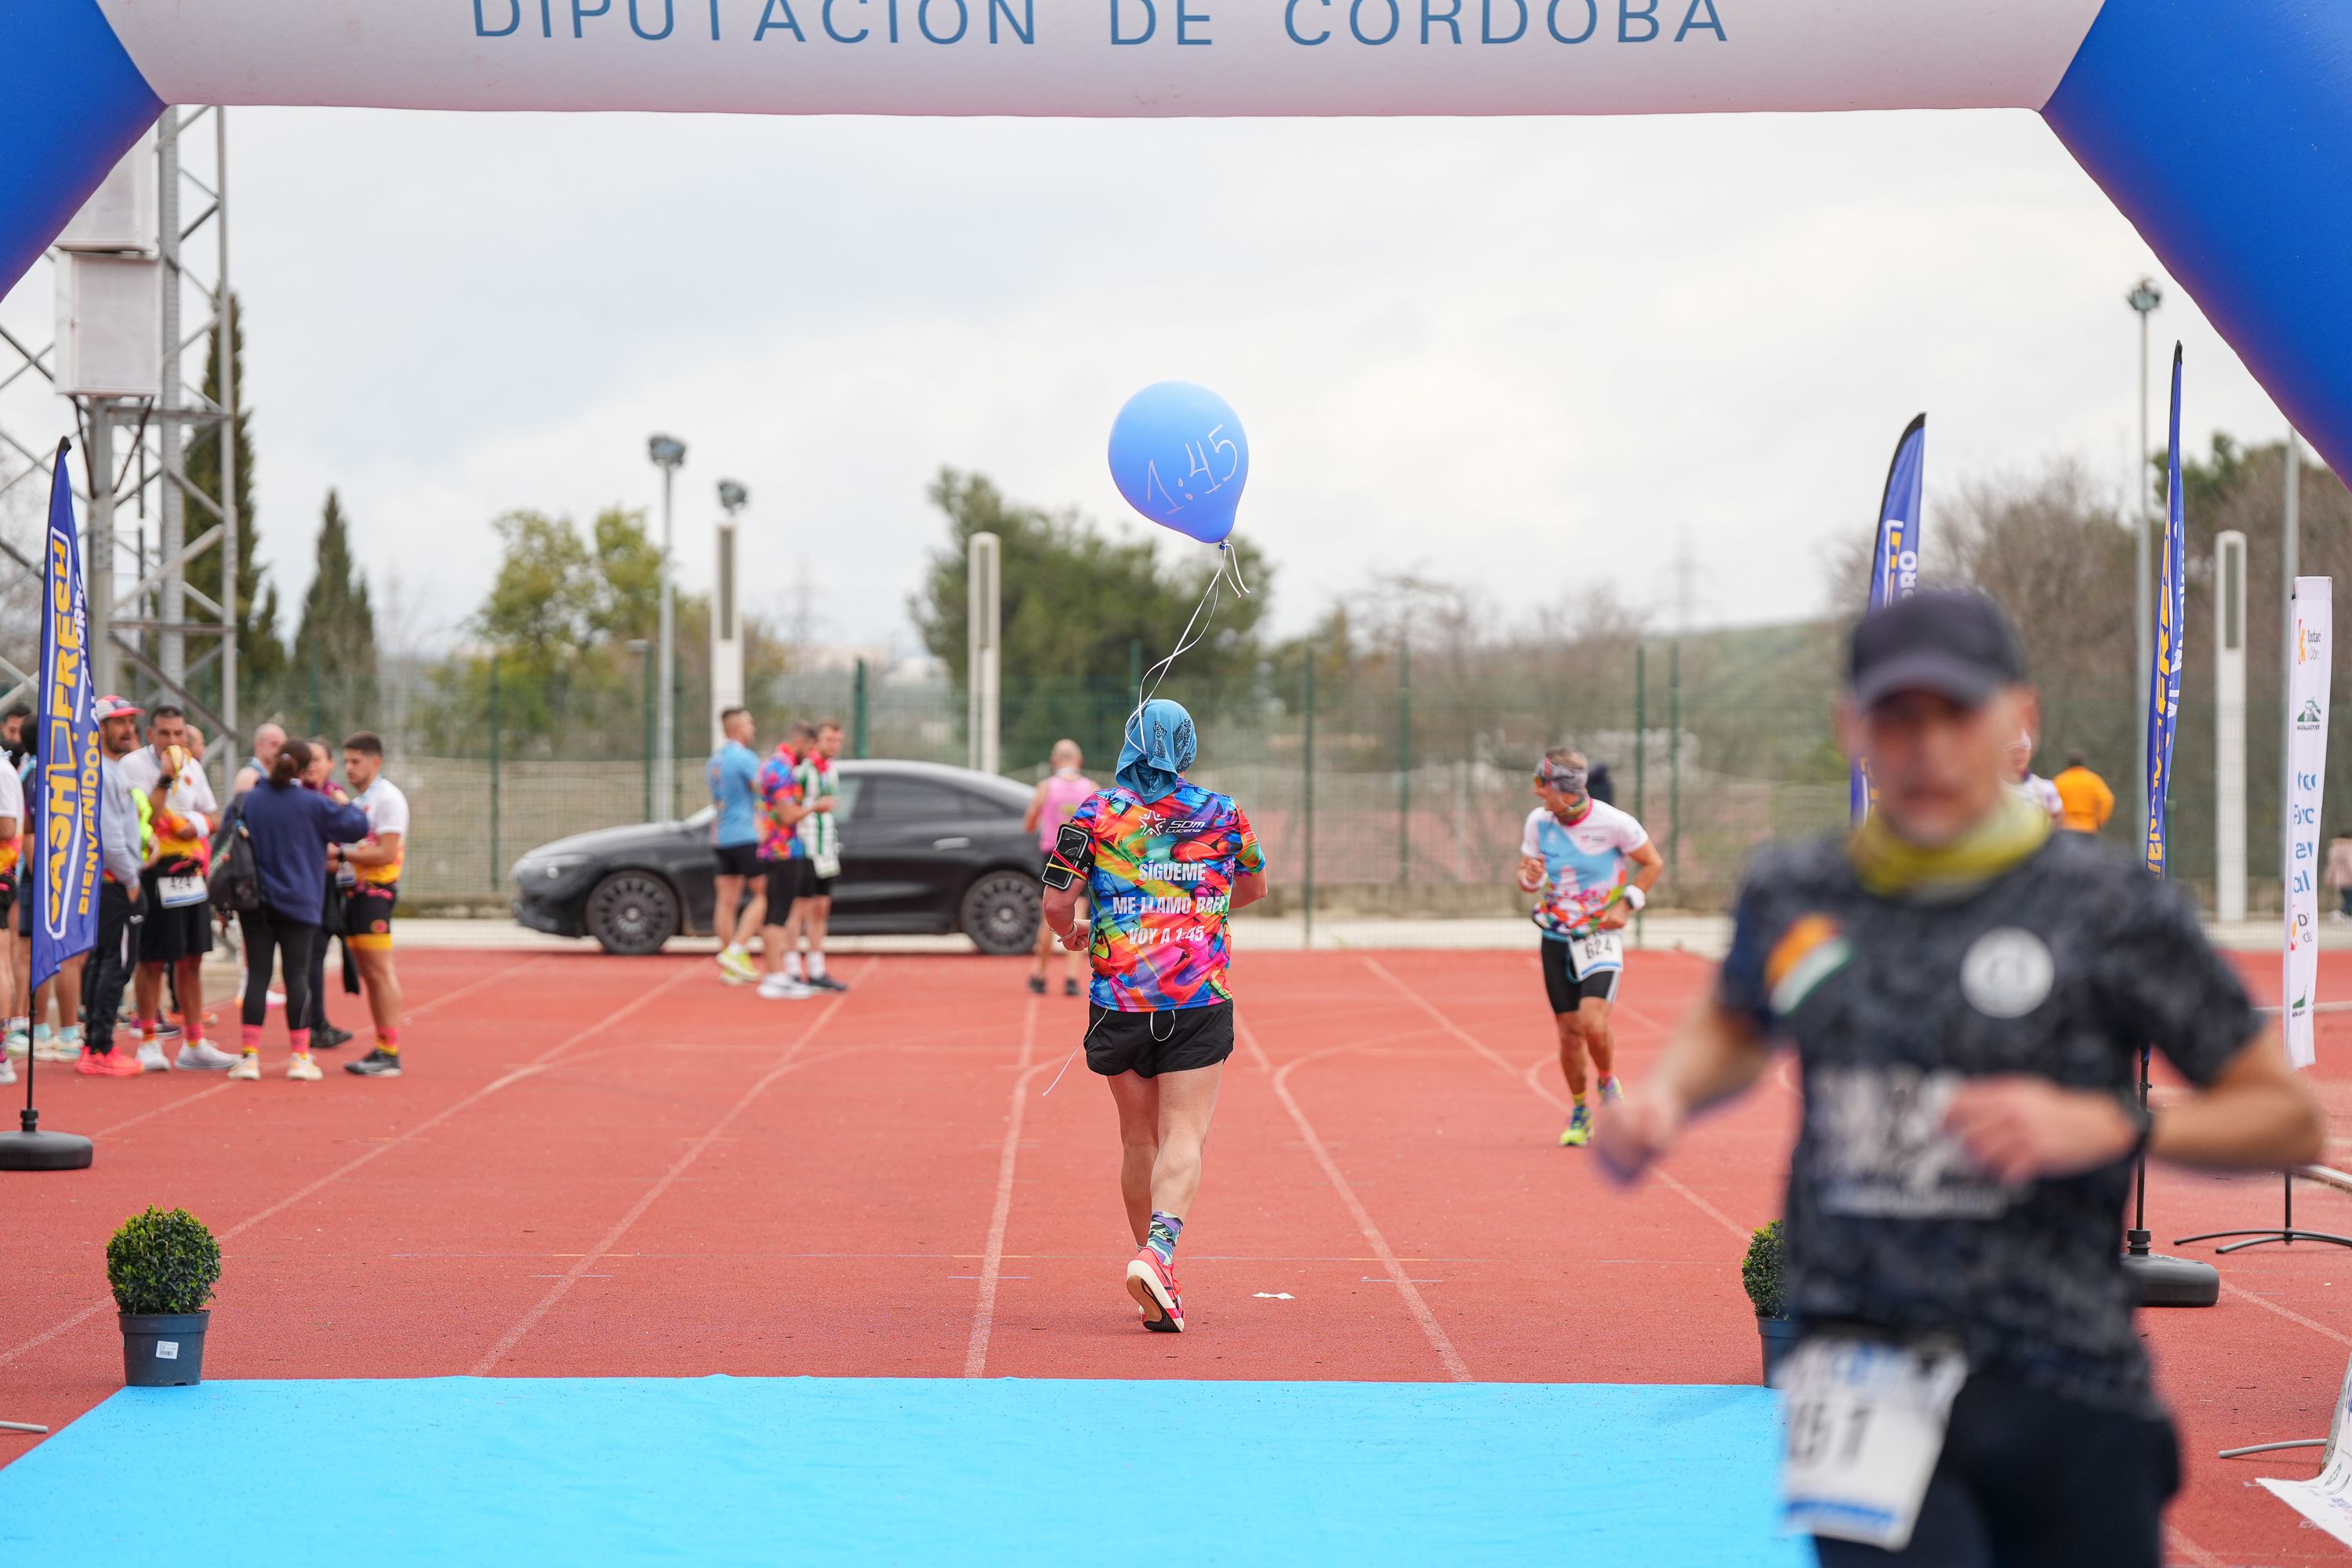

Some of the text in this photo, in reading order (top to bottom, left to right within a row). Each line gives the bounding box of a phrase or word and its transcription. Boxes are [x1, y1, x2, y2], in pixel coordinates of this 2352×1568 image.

[1110, 0, 1212, 45] DE
[1147, 423, 1238, 515] 1:45
[78, 730, 101, 916] BIENVENIDOS
[1138, 859, 1206, 881] SÍGUEME
[1112, 896, 1136, 914] ME
[1140, 896, 1191, 914] LLAMO
[1129, 926, 1205, 945] VOY A 1:45
[1585, 939, 1613, 960] 624
